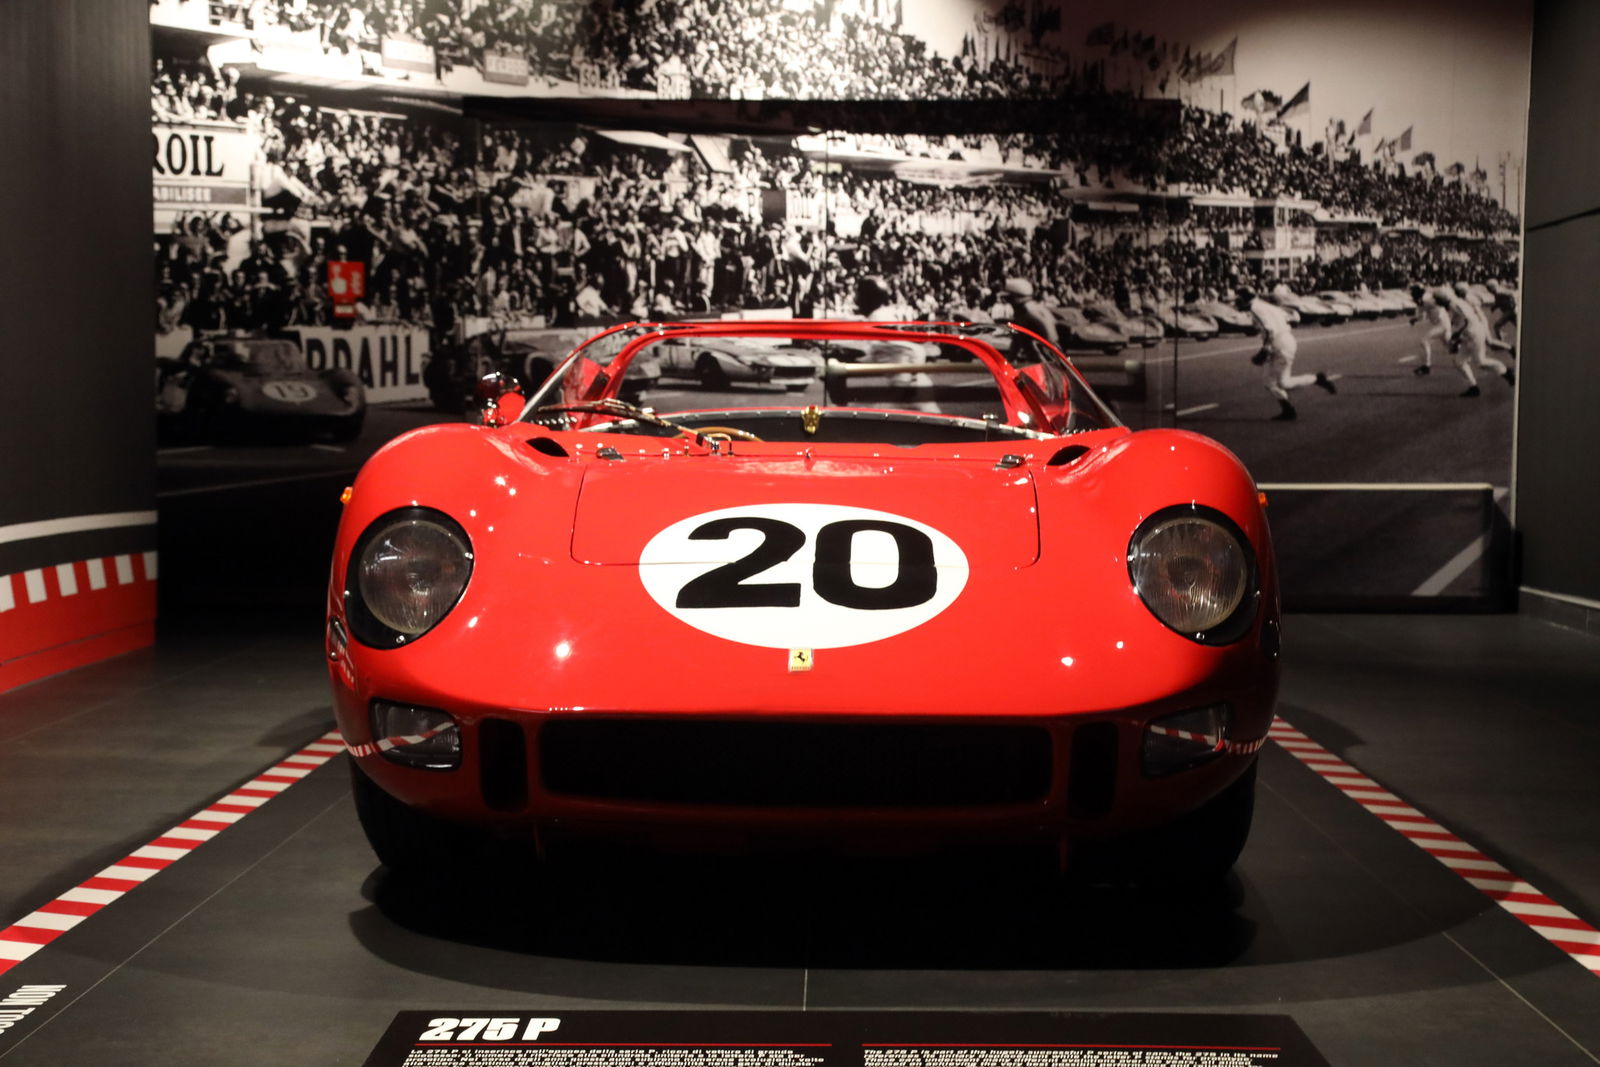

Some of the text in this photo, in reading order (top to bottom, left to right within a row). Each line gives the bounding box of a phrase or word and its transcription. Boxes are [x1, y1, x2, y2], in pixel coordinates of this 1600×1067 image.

[676, 517, 937, 610] 20
[419, 1017, 561, 1041] 275 P
